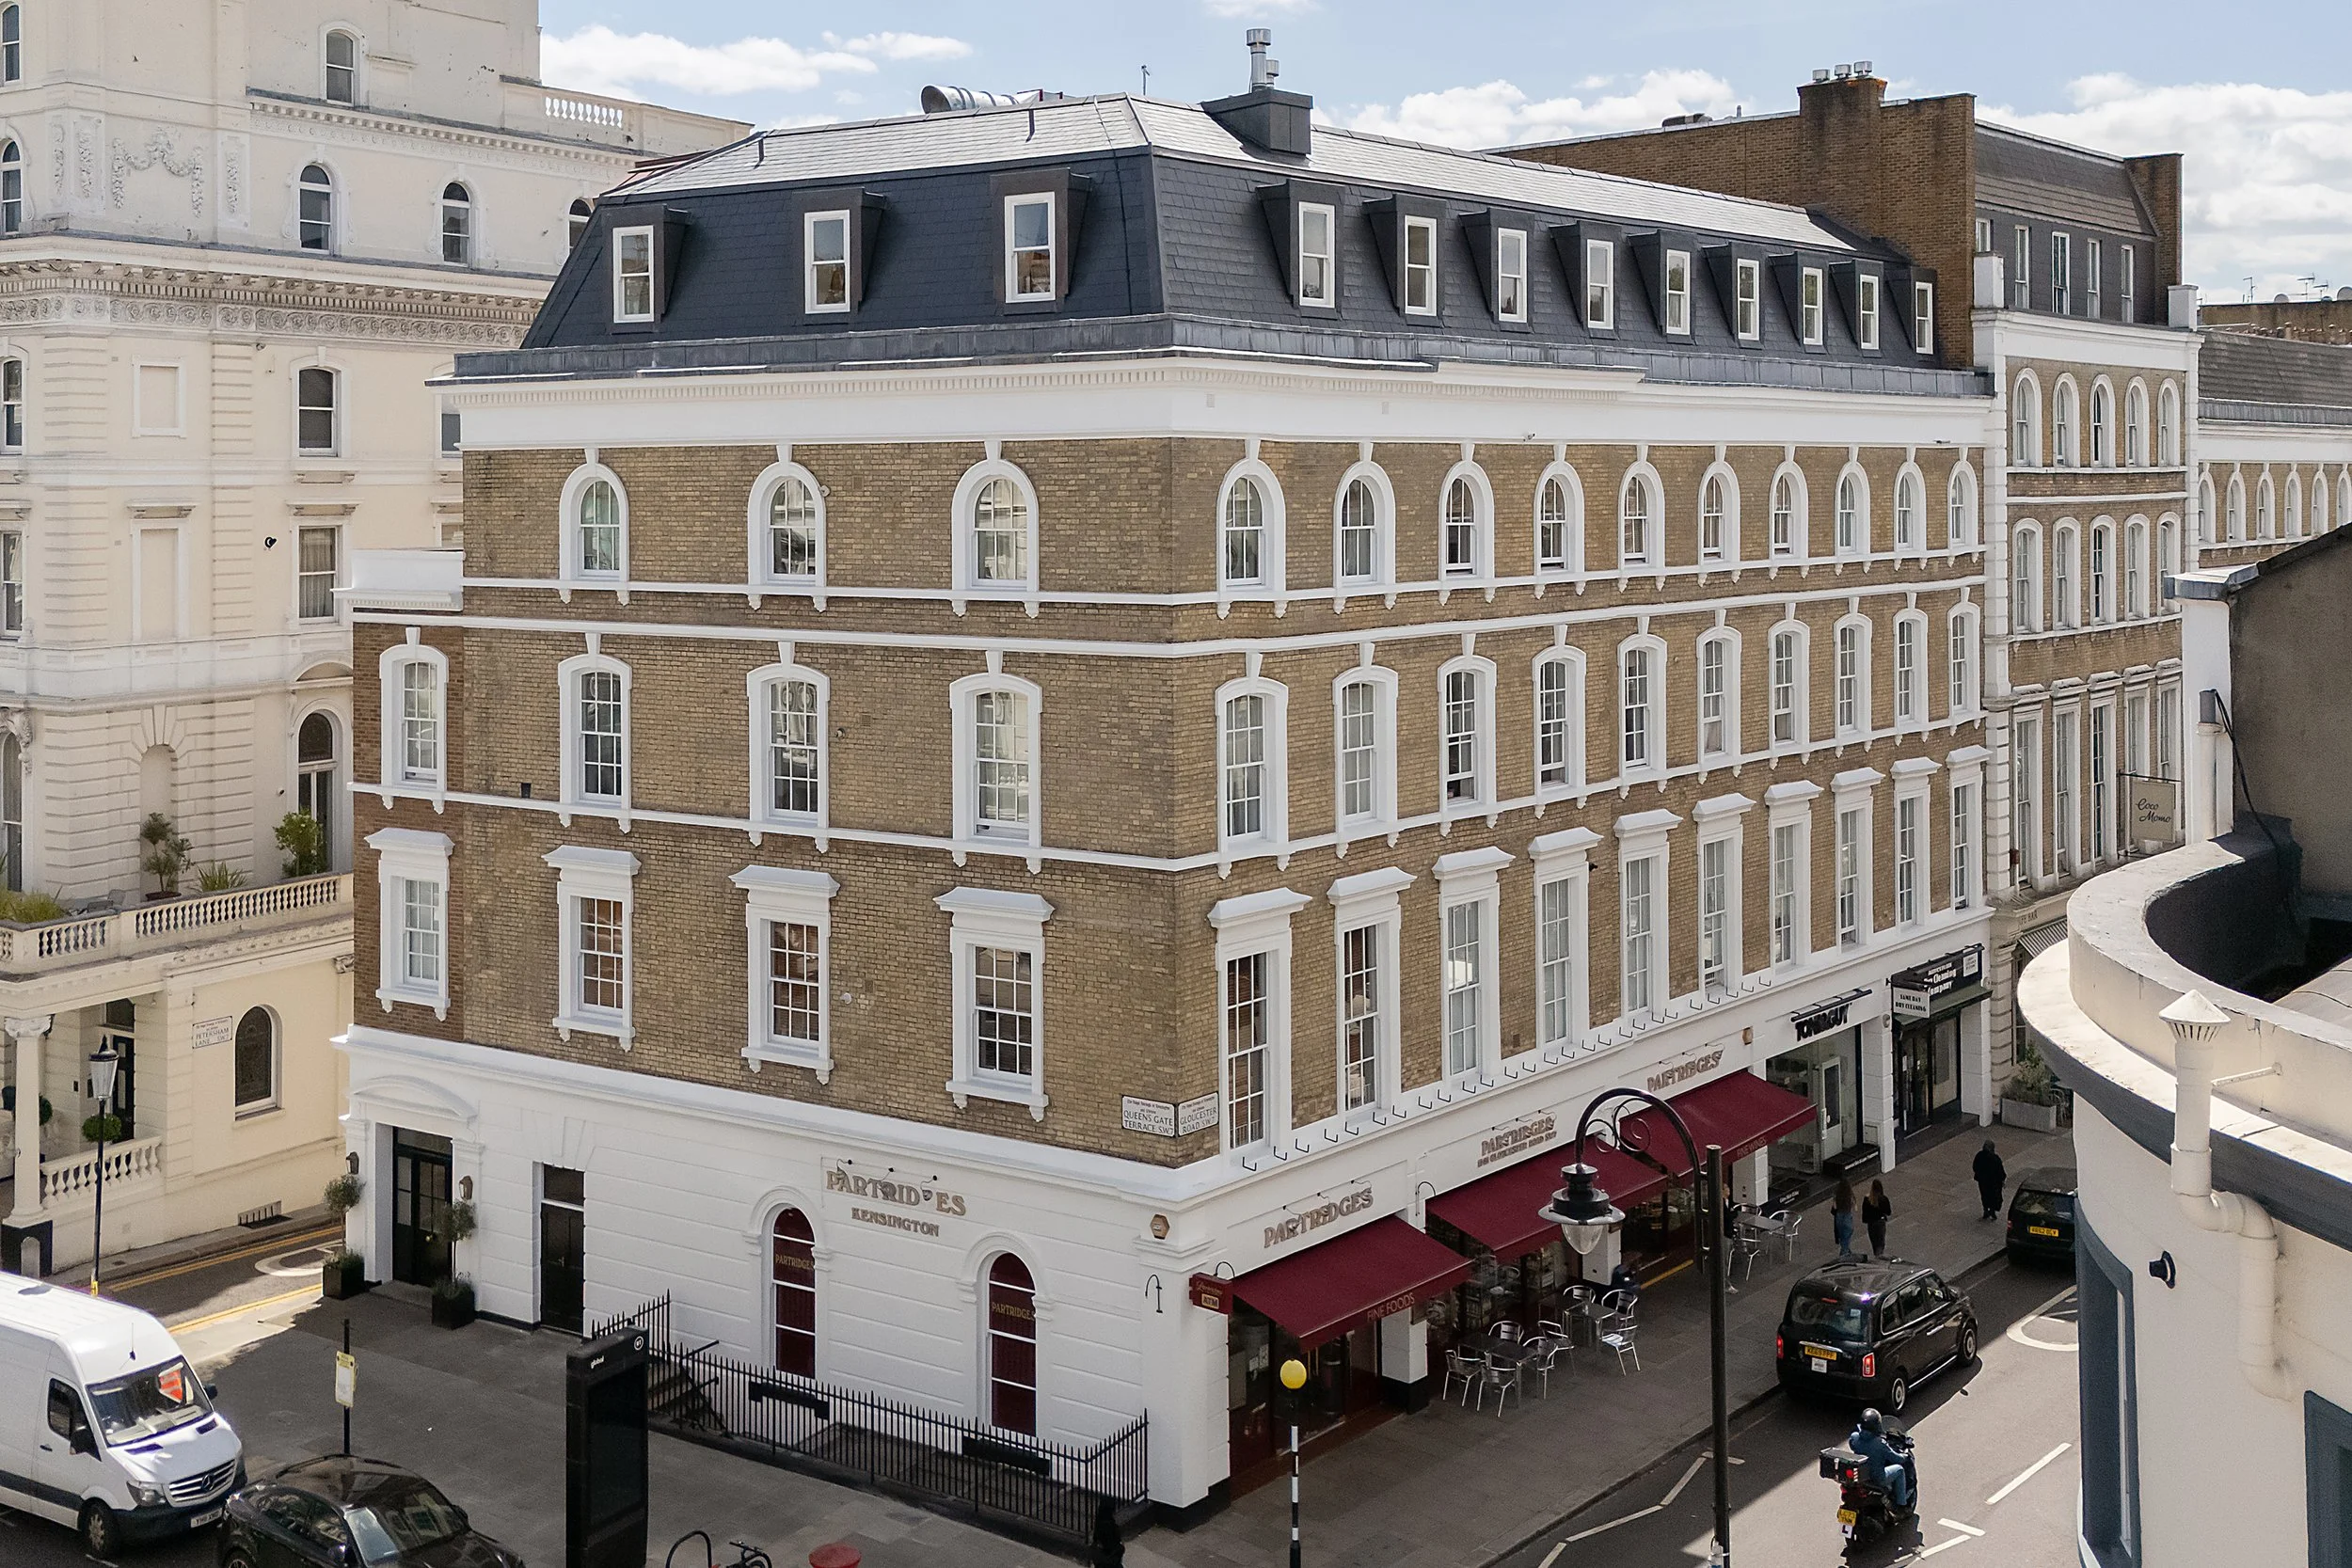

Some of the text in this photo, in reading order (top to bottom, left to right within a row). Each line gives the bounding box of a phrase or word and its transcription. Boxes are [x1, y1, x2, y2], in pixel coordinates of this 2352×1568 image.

[2137, 798, 2159, 811] Coco
[2138, 811, 2171, 823] Momo
[1153, 1115, 1173, 1127] GATE
[1180, 1107, 1217, 1126] GLOUCESTER
[1124, 1119, 1155, 1132] TERRACE
[1183, 1122, 1200, 1134] ROAD
[851, 1207, 939, 1237] KENSINGTON
[1367, 1292, 1415, 1323] FINE FOODS
